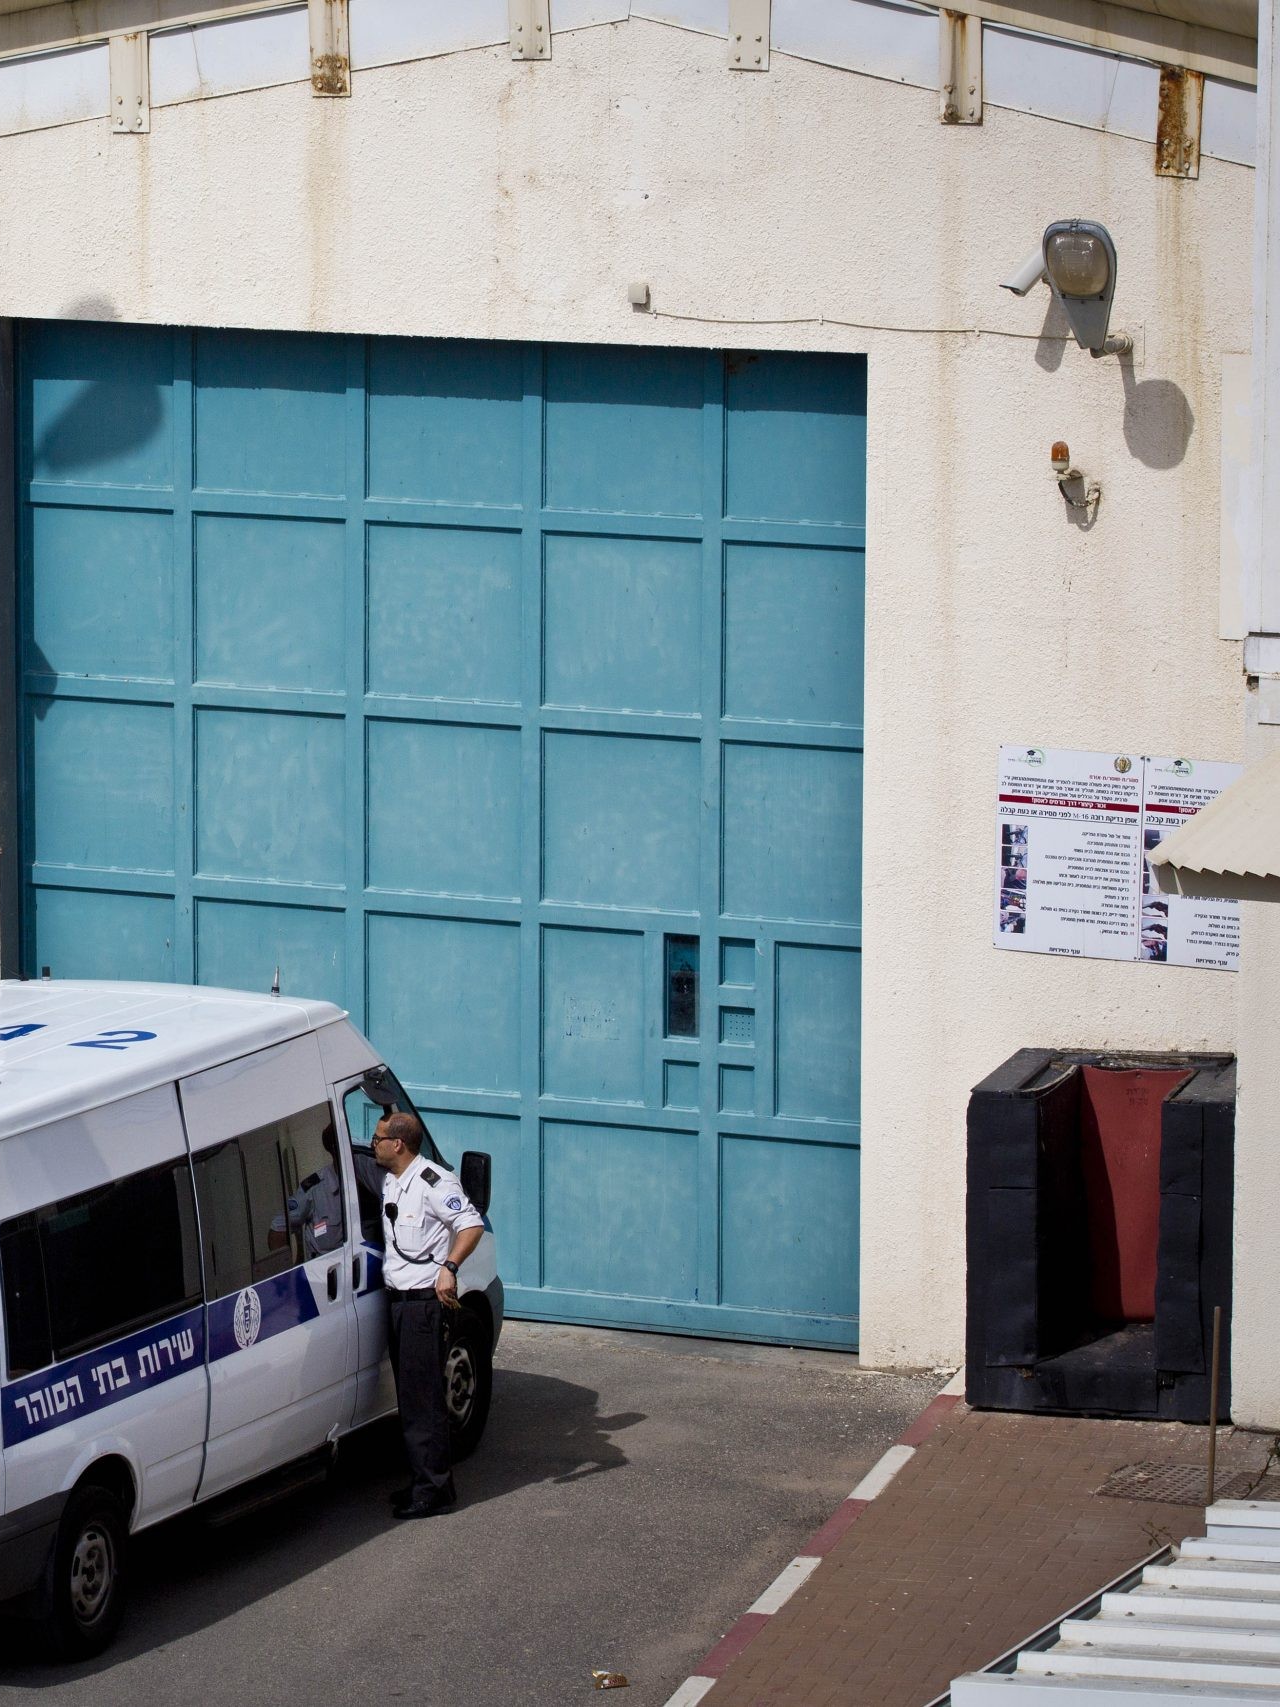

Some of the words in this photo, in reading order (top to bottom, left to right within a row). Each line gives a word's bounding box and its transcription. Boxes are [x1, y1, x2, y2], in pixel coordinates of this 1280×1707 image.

[91, 1356, 131, 1396] בתי
[137, 1327, 195, 1379] שירות
[15, 1375, 85, 1425] הסוהר
